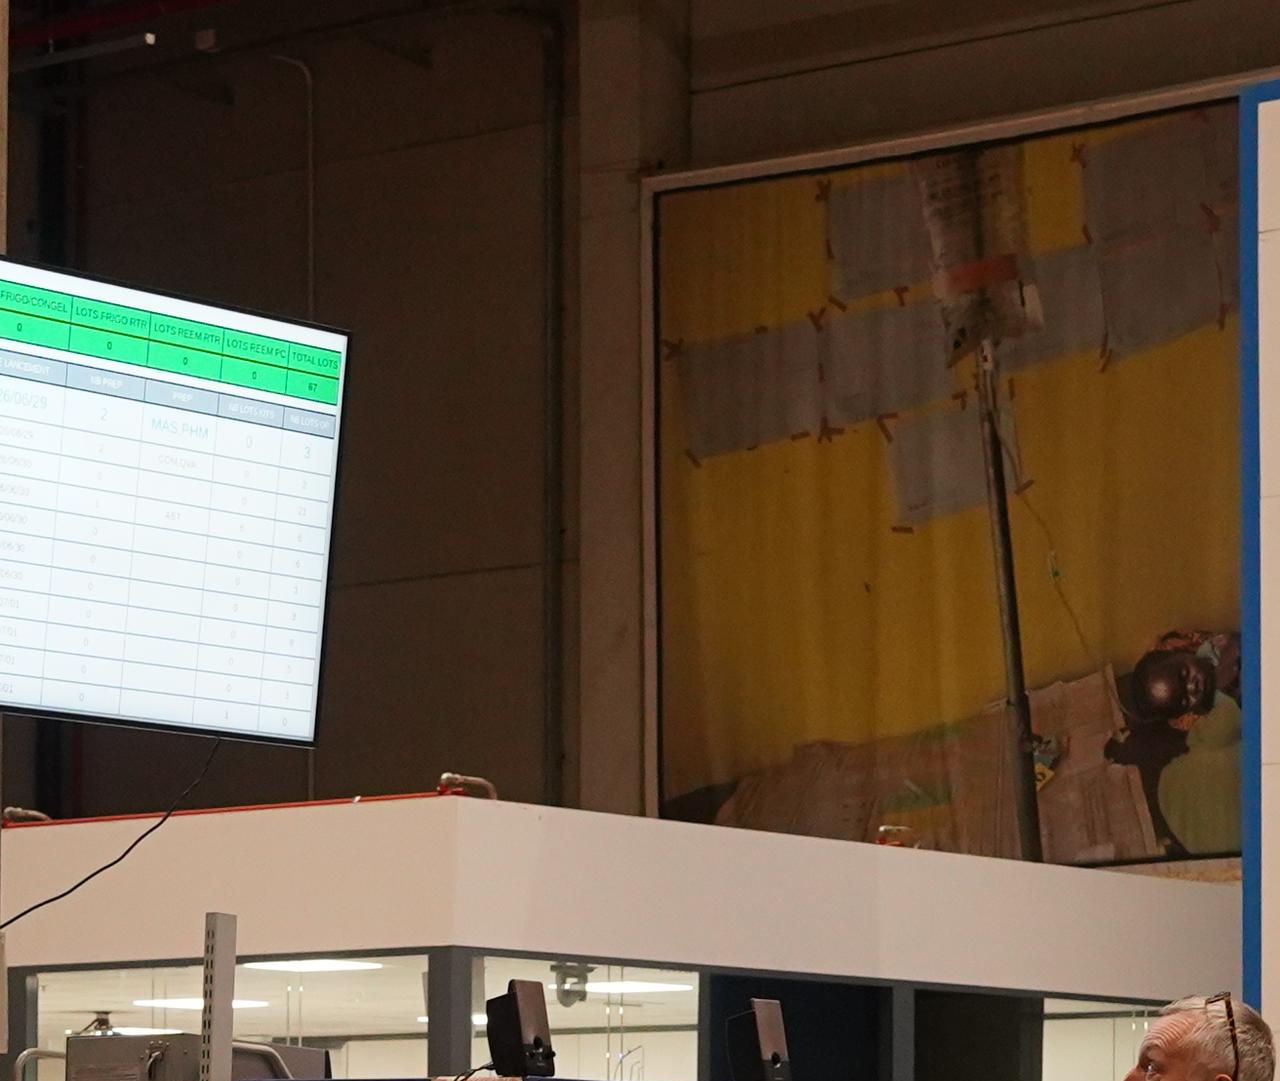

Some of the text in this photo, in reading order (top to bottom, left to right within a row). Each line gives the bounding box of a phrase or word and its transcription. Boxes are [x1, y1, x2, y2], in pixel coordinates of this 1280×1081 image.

[75, 305, 100, 320] LOTS
[153, 321, 176, 336] LOTS
[226, 337, 247, 351] LOTS
[291, 350, 339, 370] TOTAL LOTS
